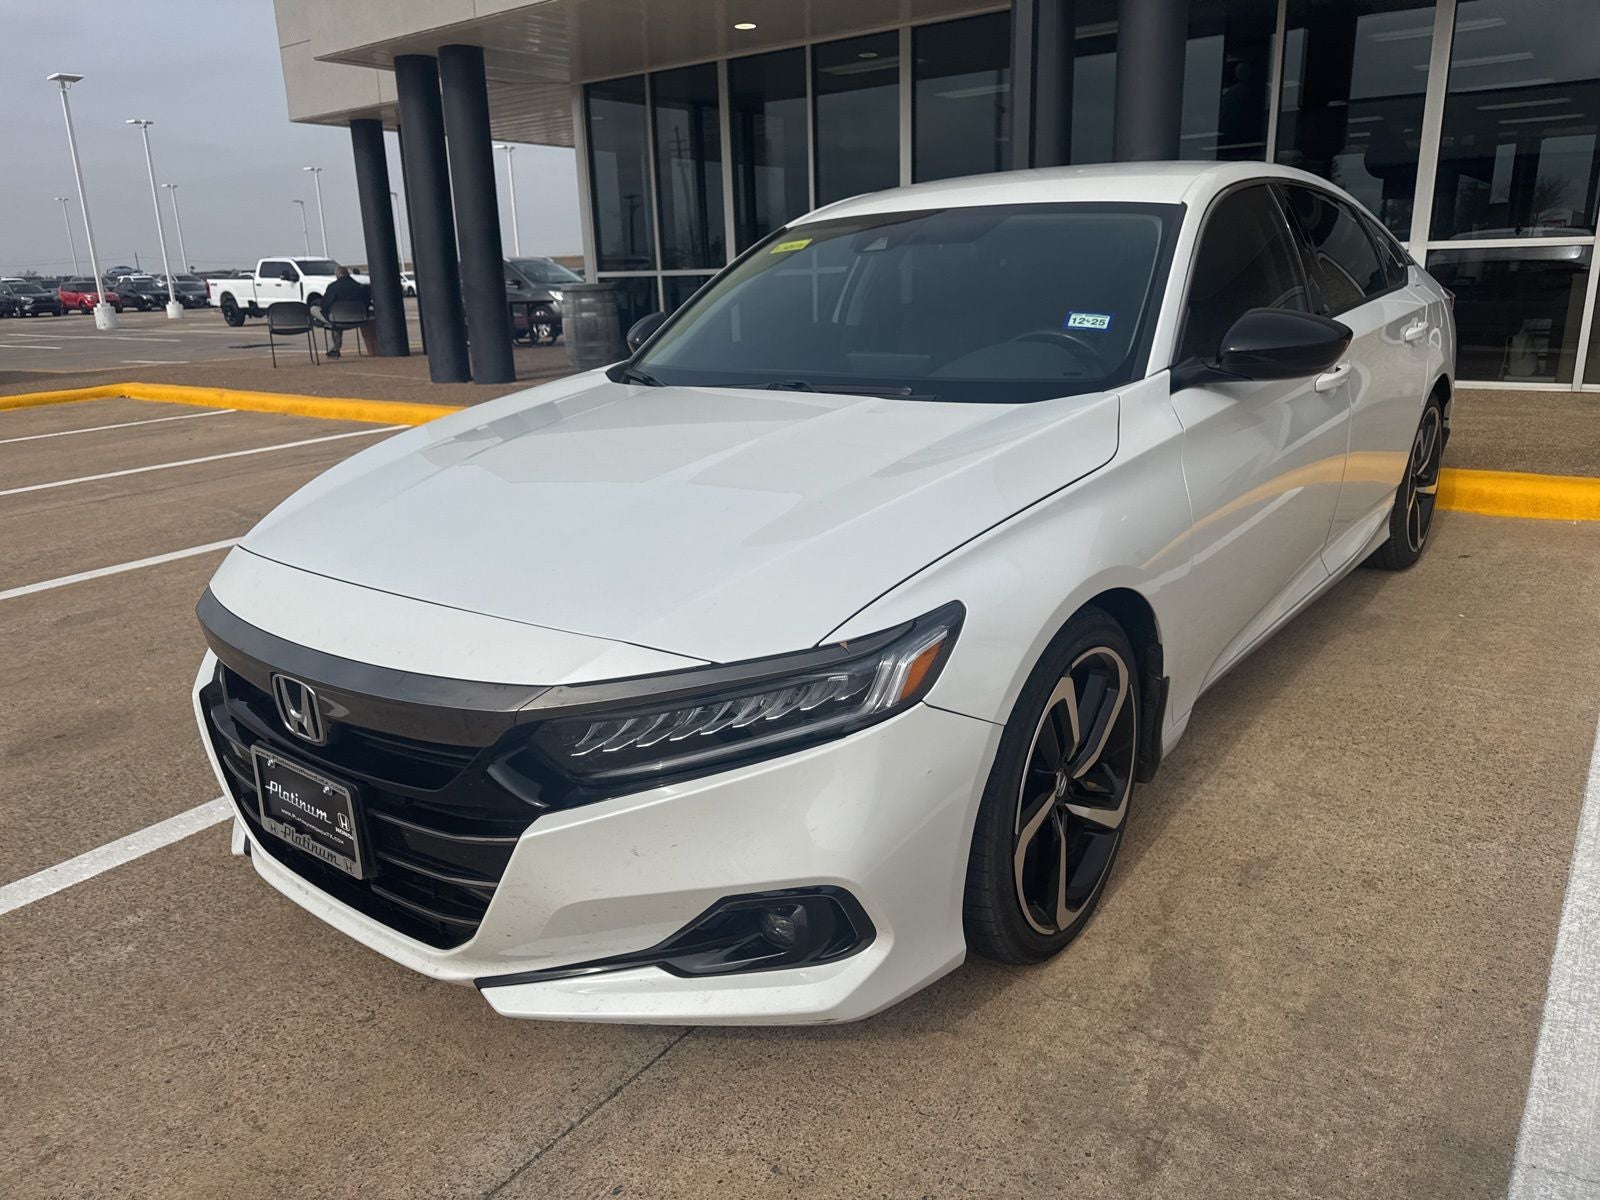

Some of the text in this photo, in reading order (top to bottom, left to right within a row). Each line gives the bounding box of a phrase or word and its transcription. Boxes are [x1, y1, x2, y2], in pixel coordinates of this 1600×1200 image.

[1072, 317, 1106, 326] 12 25
[265, 781, 332, 825] Platinum
[281, 825, 341, 867] Platinum
